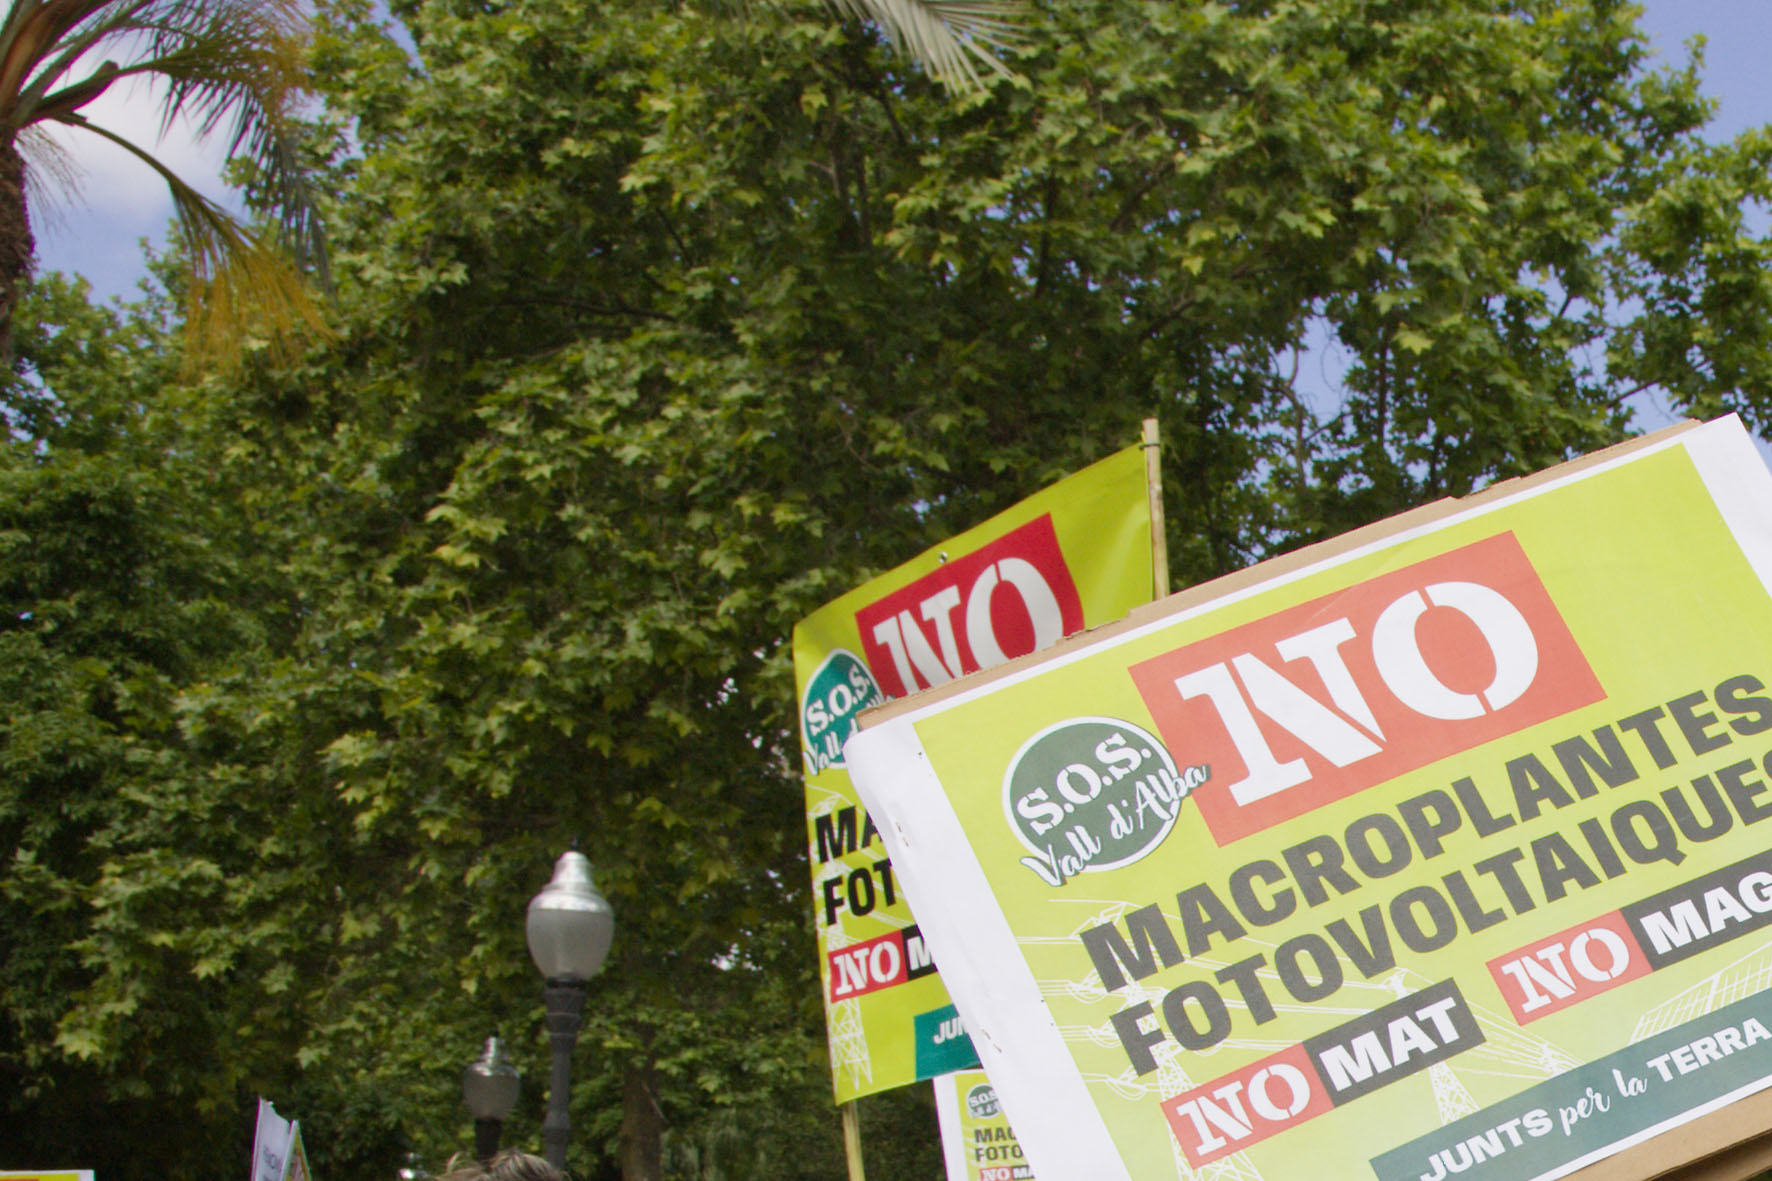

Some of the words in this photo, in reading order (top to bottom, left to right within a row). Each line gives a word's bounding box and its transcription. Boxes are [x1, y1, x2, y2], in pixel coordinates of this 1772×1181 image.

[873, 557, 1063, 696] NO
[1174, 581, 1538, 807] NO
[1017, 733, 1152, 836] S.O.S.
[1019, 824, 1102, 886] Vall
[1109, 762, 1211, 841] d'Alba
[833, 941, 900, 995] NO
[1176, 1063, 1310, 1156] NO
[1319, 997, 1460, 1091] MAT
[1502, 928, 1629, 1013] NO
[1559, 1087, 1610, 1136] per
[1612, 1069, 1648, 1098] la
[1646, 1017, 1772, 1082] TERRA
[982, 1168, 1011, 1181] NO
